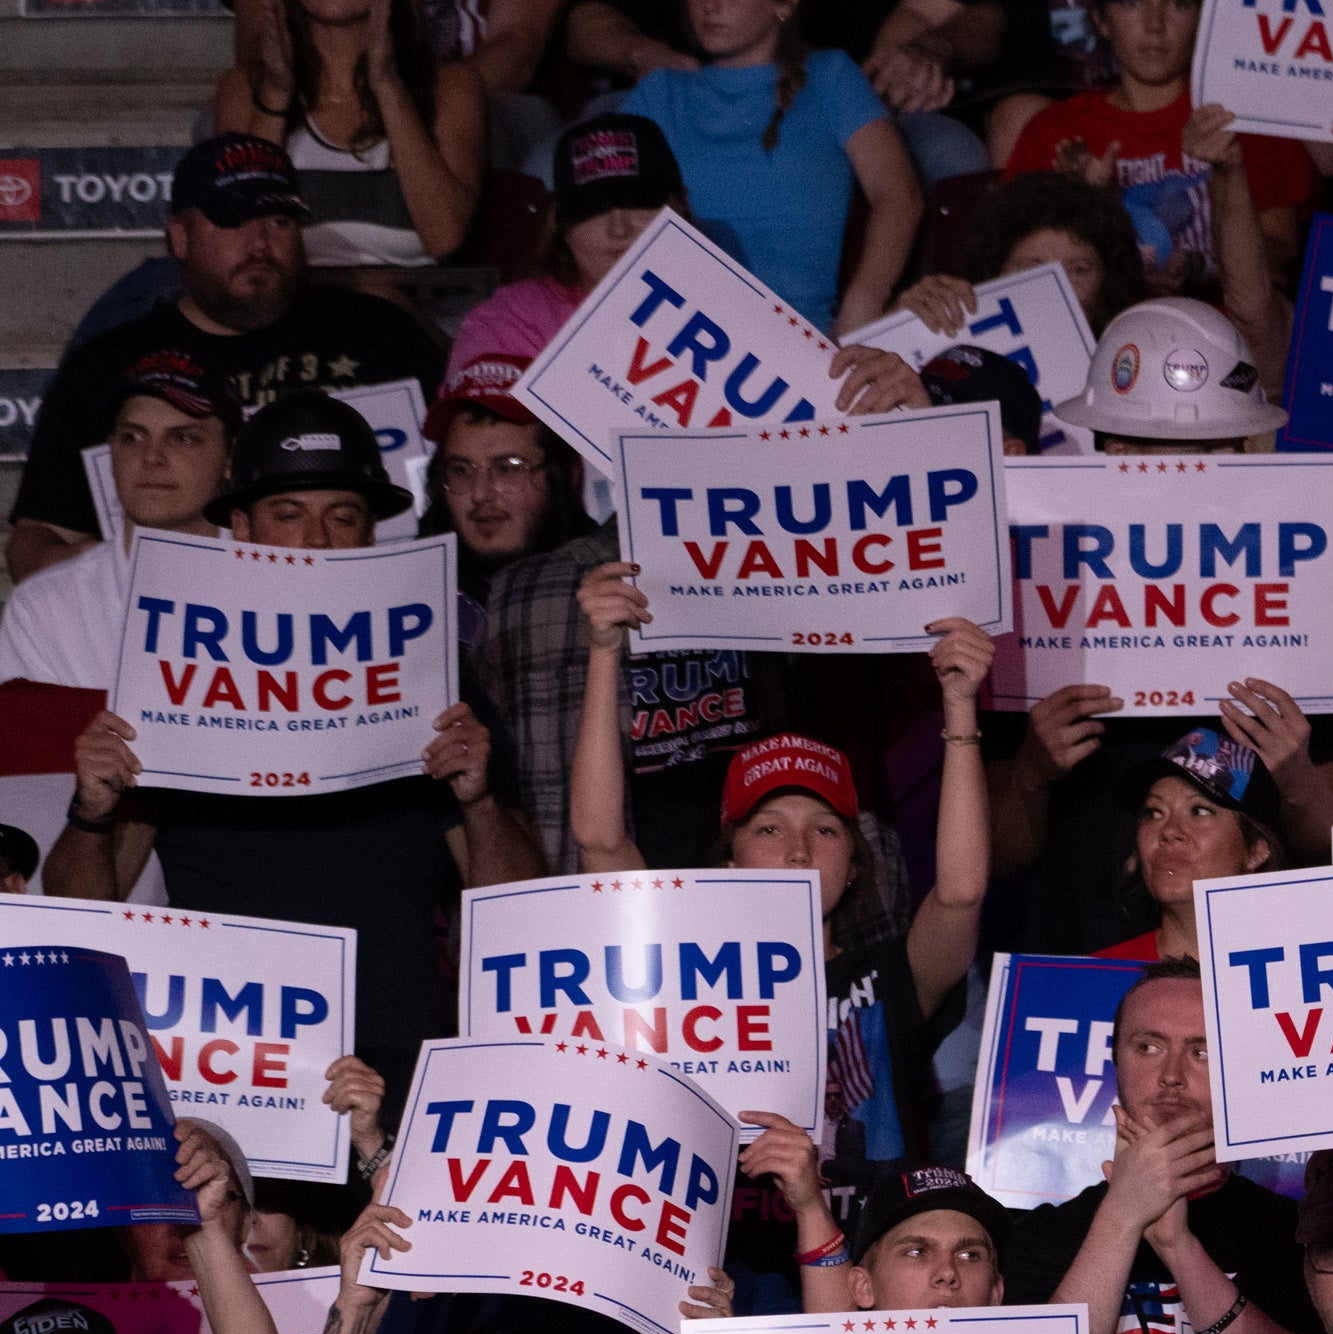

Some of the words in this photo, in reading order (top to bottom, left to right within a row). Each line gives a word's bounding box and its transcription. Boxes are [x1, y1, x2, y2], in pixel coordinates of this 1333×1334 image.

[55, 174, 174, 201] TOYOT
[641, 469, 978, 536] TRUMP
[684, 528, 945, 579] VANCE
[1009, 523, 1327, 580] TRUMP
[670, 586, 723, 596] MAKE
[732, 585, 819, 596] AMERICA
[827, 581, 889, 595] GREAT
[899, 573, 965, 590] AGAIN!
[1035, 583, 1289, 629] VANCE
[138, 596, 433, 665] TRUMP
[793, 632, 853, 645] 2024
[160, 661, 401, 712] VANCE
[1135, 691, 1195, 706] 2024
[739, 736, 779, 764] MAKE
[781, 731, 842, 762] AMERICA
[251, 772, 310, 787] 2024
[742, 761, 791, 788] GREAT
[796, 759, 839, 785] AGAIN
[481, 942, 802, 1007] TRUMP
[1261, 1065, 1317, 1083] MAKE
[425, 1099, 718, 1212] TRUMP
[37, 1200, 99, 1221] 2024
[448, 1158, 691, 1256] VANCE
[520, 1271, 584, 1296] 2024
